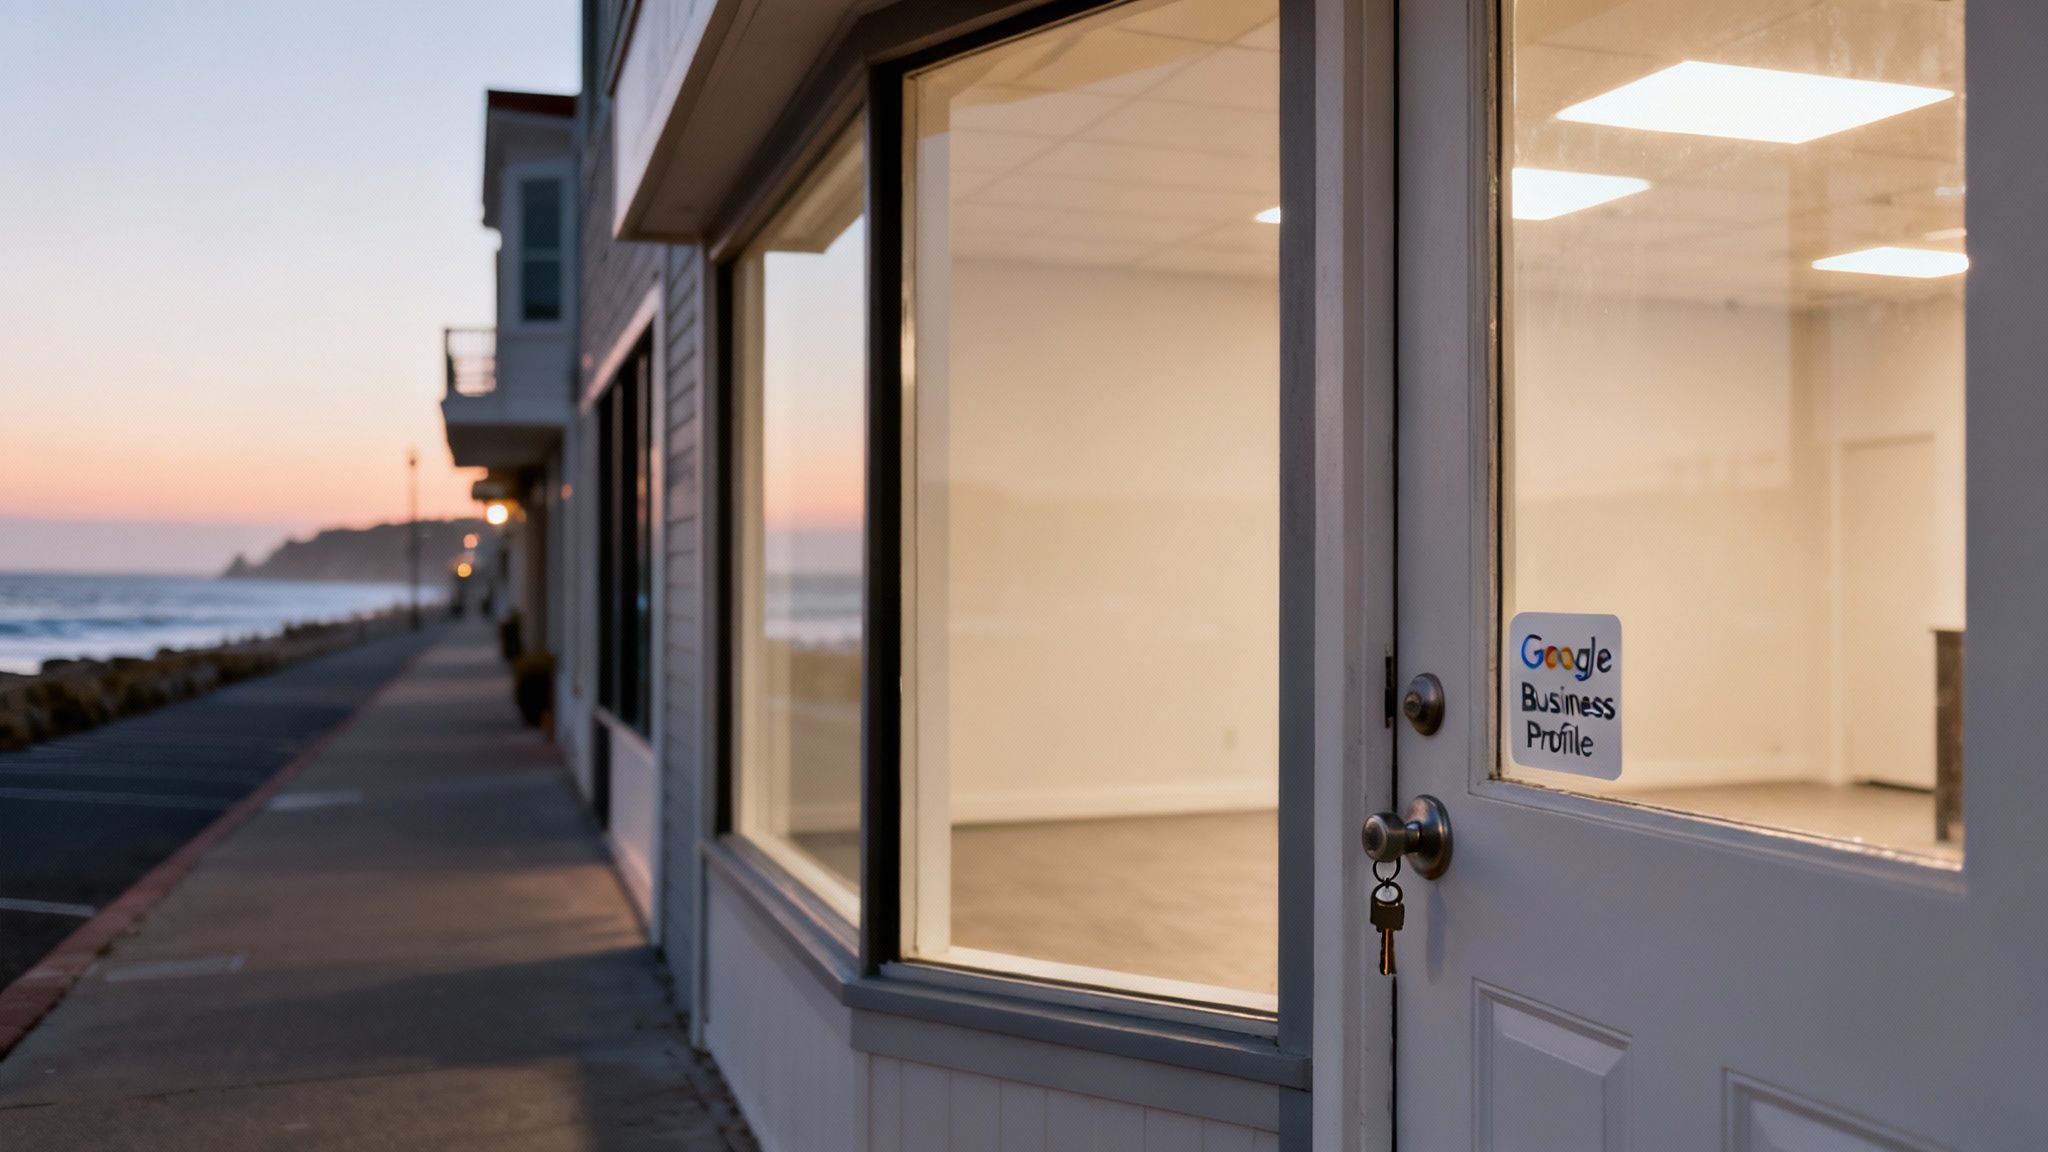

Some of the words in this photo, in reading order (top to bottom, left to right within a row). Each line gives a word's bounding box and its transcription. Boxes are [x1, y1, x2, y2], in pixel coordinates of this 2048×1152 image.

[1521, 634, 1612, 681] Google
[1521, 682, 1616, 720] Business
[1527, 720, 1594, 757] Profile
